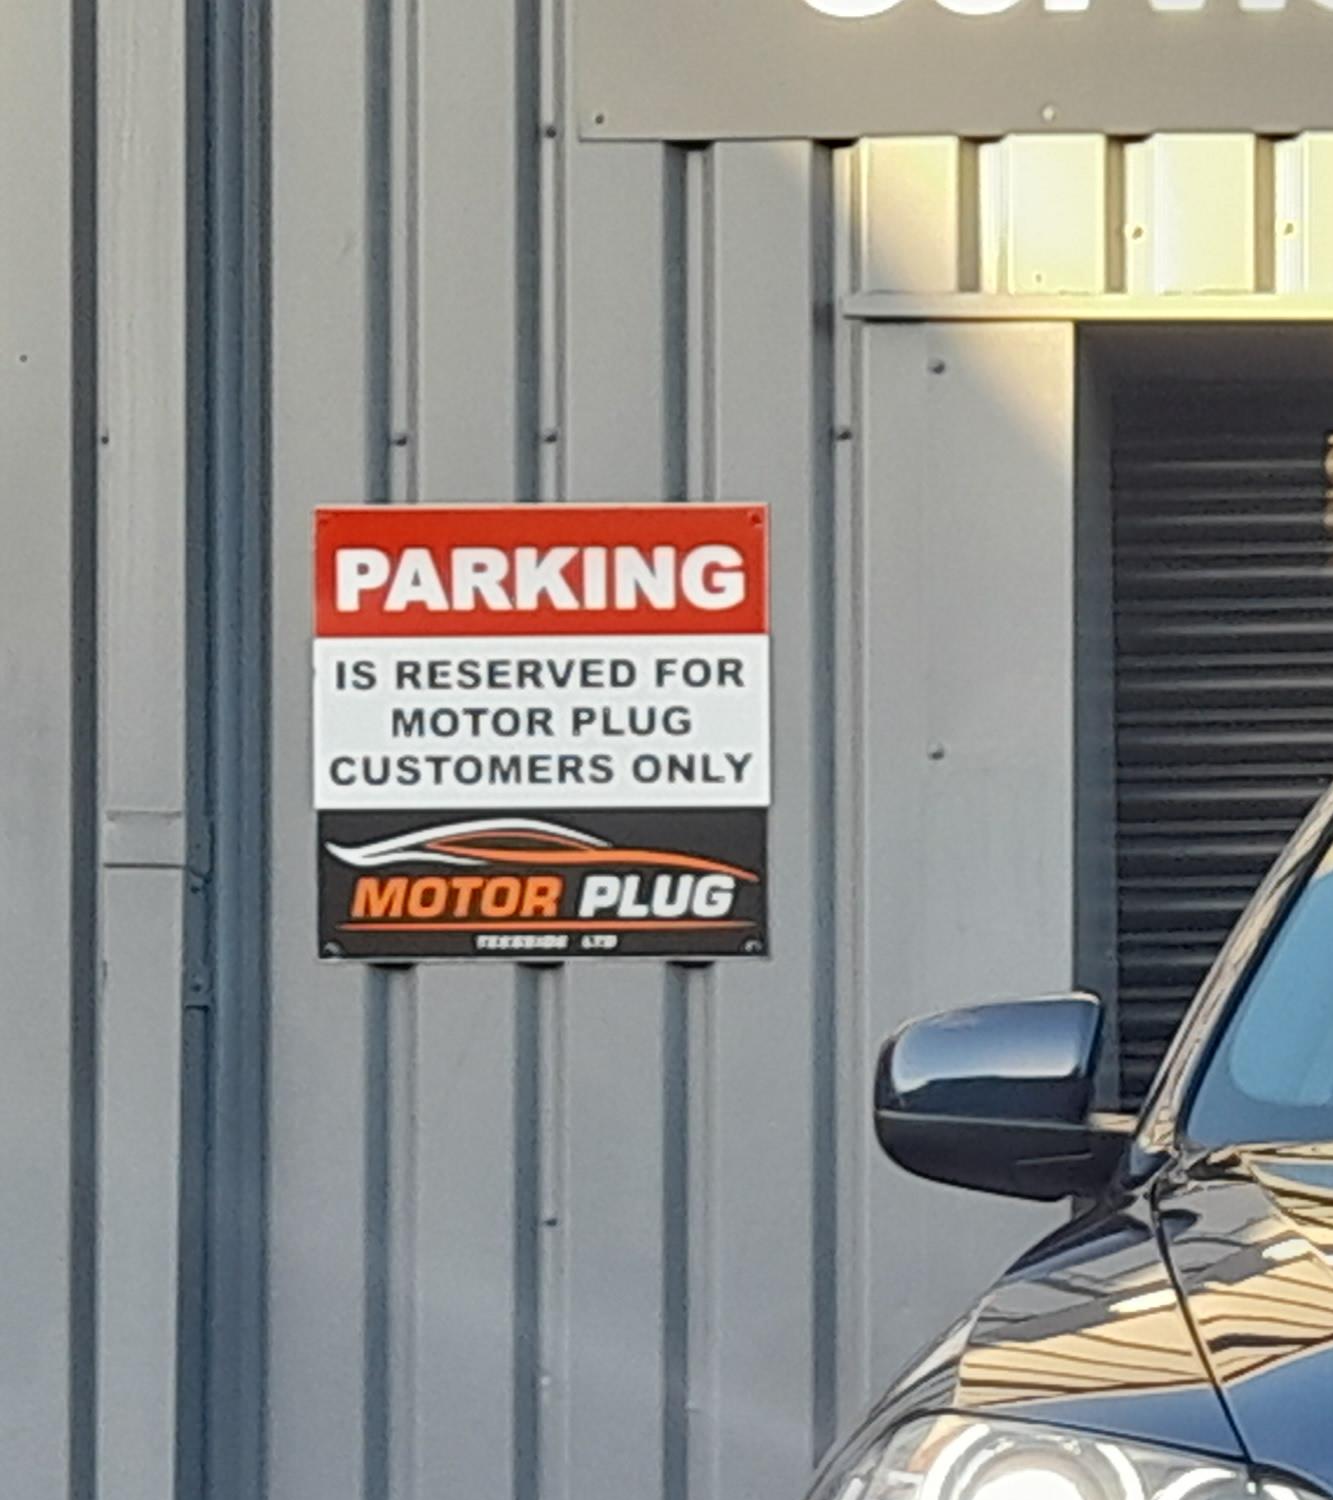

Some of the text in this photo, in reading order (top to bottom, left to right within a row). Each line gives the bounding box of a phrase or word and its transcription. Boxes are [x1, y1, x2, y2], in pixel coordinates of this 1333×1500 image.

[336, 545, 745, 612] PARKING
[336, 658, 744, 690] IS RESERVED FOR
[391, 706, 692, 737] MOTOR PLUG
[329, 753, 752, 786] CUSTOMERS ONLY
[351, 874, 736, 919] MOTOR PLUG
